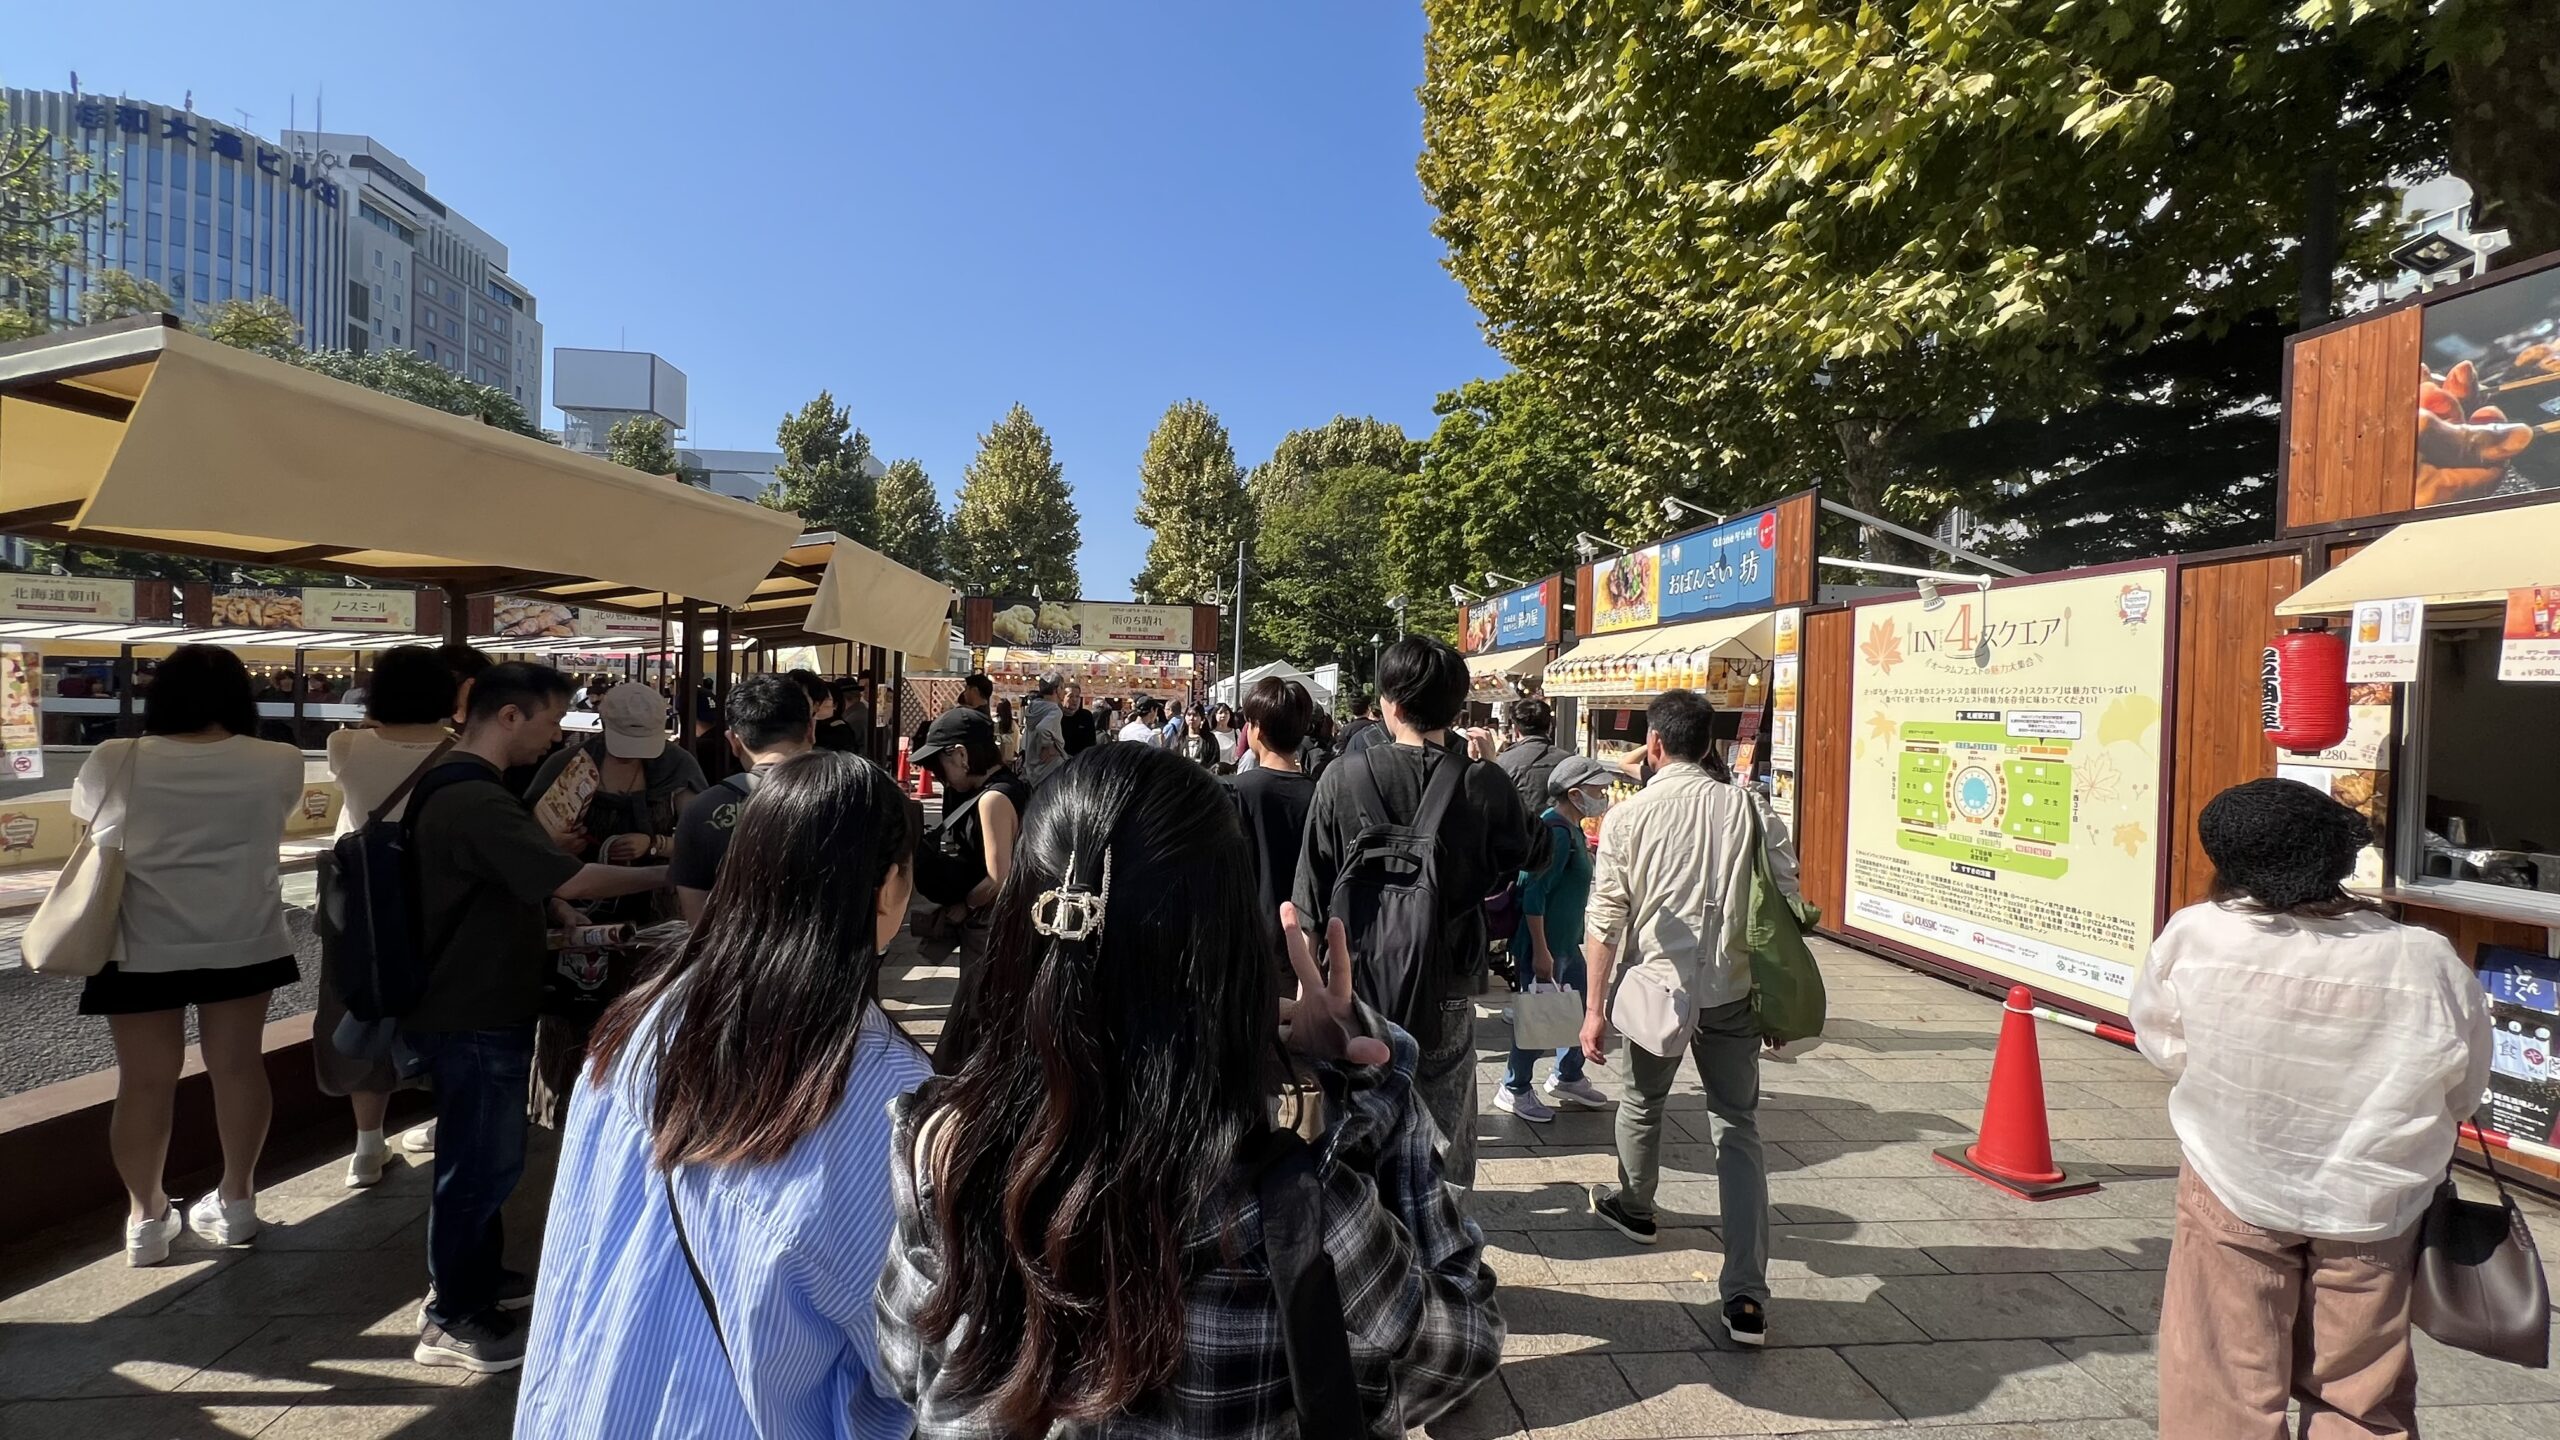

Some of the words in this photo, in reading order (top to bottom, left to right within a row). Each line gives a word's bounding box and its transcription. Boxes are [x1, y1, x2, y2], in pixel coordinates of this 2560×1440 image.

[1669, 561, 1733, 595] おばんざい
[1739, 549, 1760, 586] 坊
[10, 587, 101, 602] 北海道朝市
[331, 601, 387, 613] ノースミール
[1112, 614, 1162, 626] 雨のち晴れ
[1053, 649, 1099, 662] Beer
[1915, 916, 1937, 930] CLASSIC
